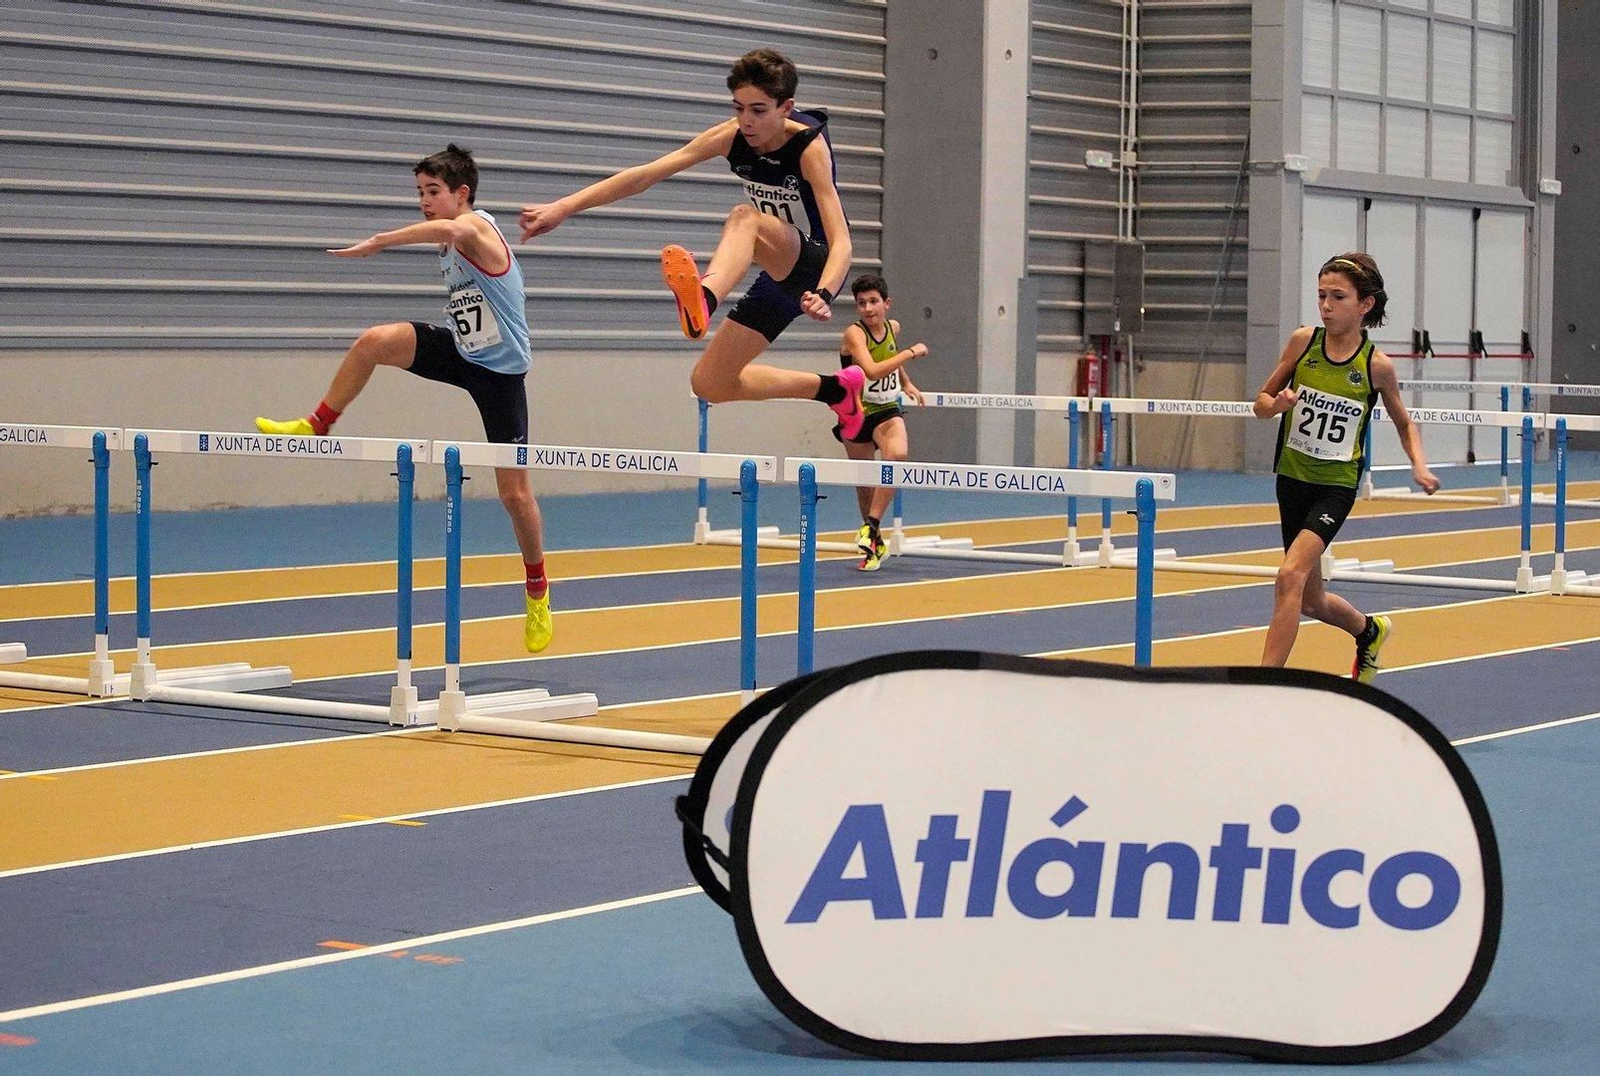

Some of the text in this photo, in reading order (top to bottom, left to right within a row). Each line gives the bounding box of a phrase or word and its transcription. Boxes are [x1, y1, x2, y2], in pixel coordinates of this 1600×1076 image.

[744, 183, 800, 202] tlántico
[751, 197, 794, 224] 01
[868, 373, 896, 392] 203
[947, 396, 1033, 408] XUNTA DE GALICIA
[1160, 402, 1251, 413] XUNTA DE GALICIA
[1298, 390, 1362, 417] Atlántico
[1298, 406, 1348, 443] 215
[1423, 411, 1437, 421] DE
[1440, 412, 1483, 423] GALICIA
[215, 436, 343, 455] XUNTA DE GALICIA
[535, 449, 678, 472] XUNTA DE GALICIA
[902, 468, 1066, 492] XUNTA DE GALICIA
[800, 520, 808, 554] MONDO
[785, 790, 1462, 931] Atlántico
